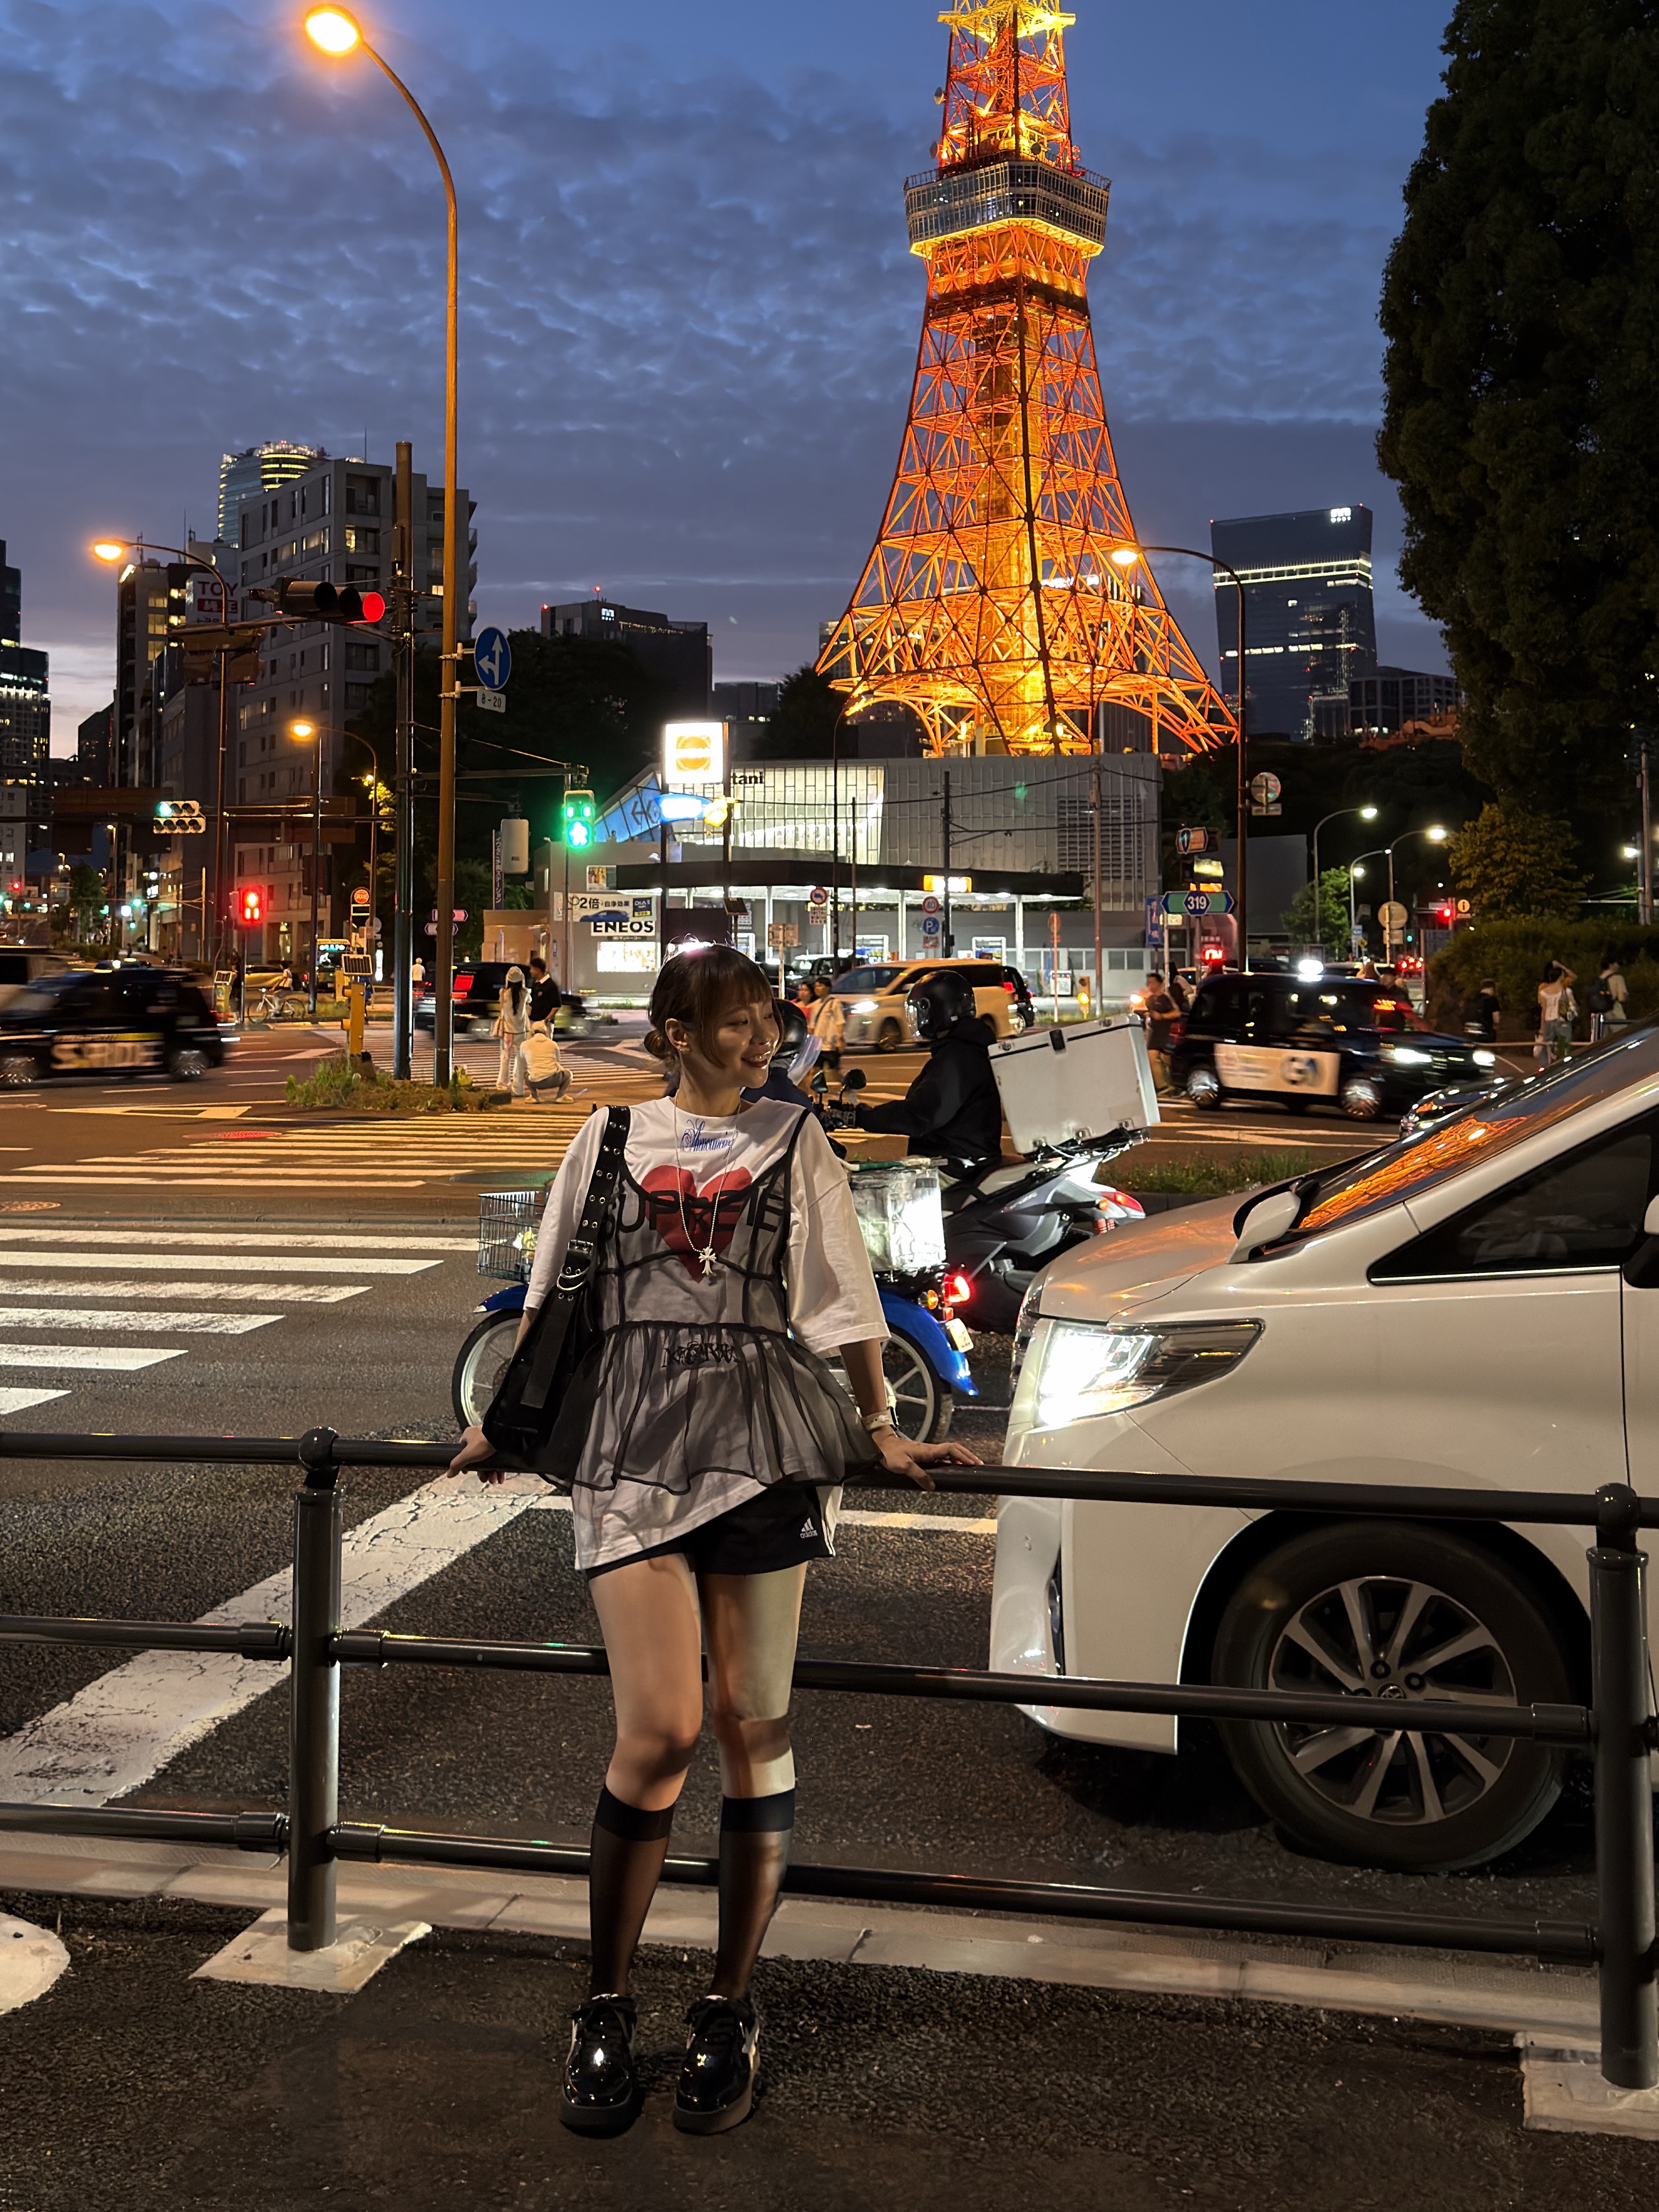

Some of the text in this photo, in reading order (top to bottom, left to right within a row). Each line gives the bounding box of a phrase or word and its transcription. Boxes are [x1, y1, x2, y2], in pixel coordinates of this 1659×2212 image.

[481, 693, 502, 708] 8-20
[733, 771, 764, 785] tani
[927, 901, 936, 909] 40
[1187, 895, 1207, 910] 319
[593, 921, 653, 933] ENEOS
[926, 920, 934, 932] P
